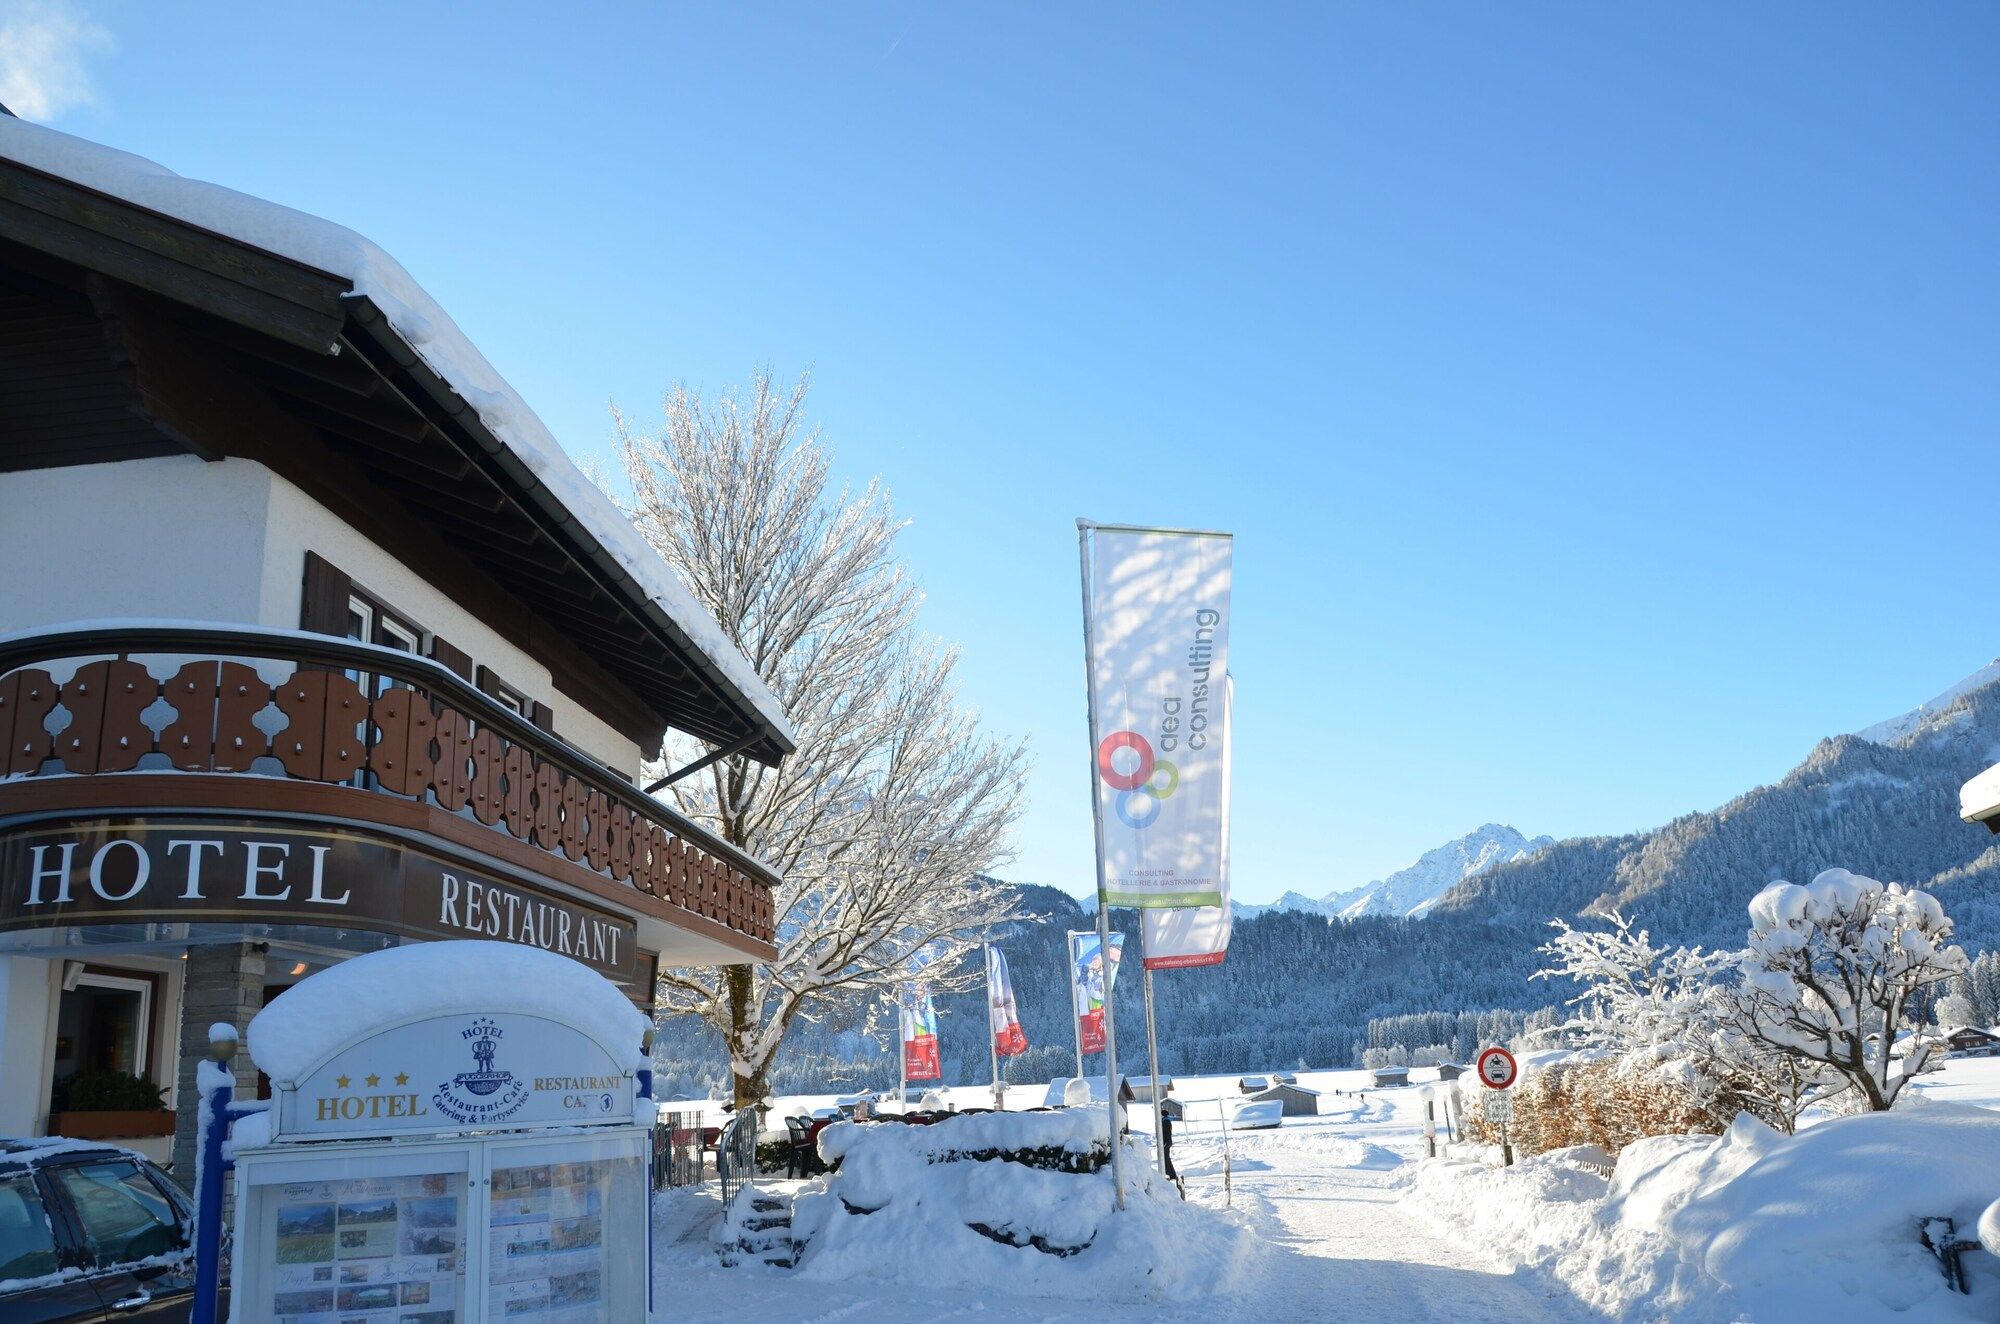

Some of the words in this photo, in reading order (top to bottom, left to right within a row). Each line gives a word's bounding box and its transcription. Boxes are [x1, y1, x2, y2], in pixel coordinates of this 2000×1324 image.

[1188, 608, 1220, 751] consulting
[23, 839, 351, 905] HOTEL
[1106, 878, 1151, 887] HOTELLERIE
[1159, 877, 1212, 887] GASTRONOMIE
[1128, 869, 1175, 877] CONSULTING
[439, 872, 621, 966] RESTAURANT
[461, 1026, 503, 1040] HOTEL
[533, 1075, 621, 1091] RESTAURANT
[316, 1094, 427, 1121] HOTEL
[432, 1094, 466, 1124] Catering
[468, 1113, 478, 1124] &
